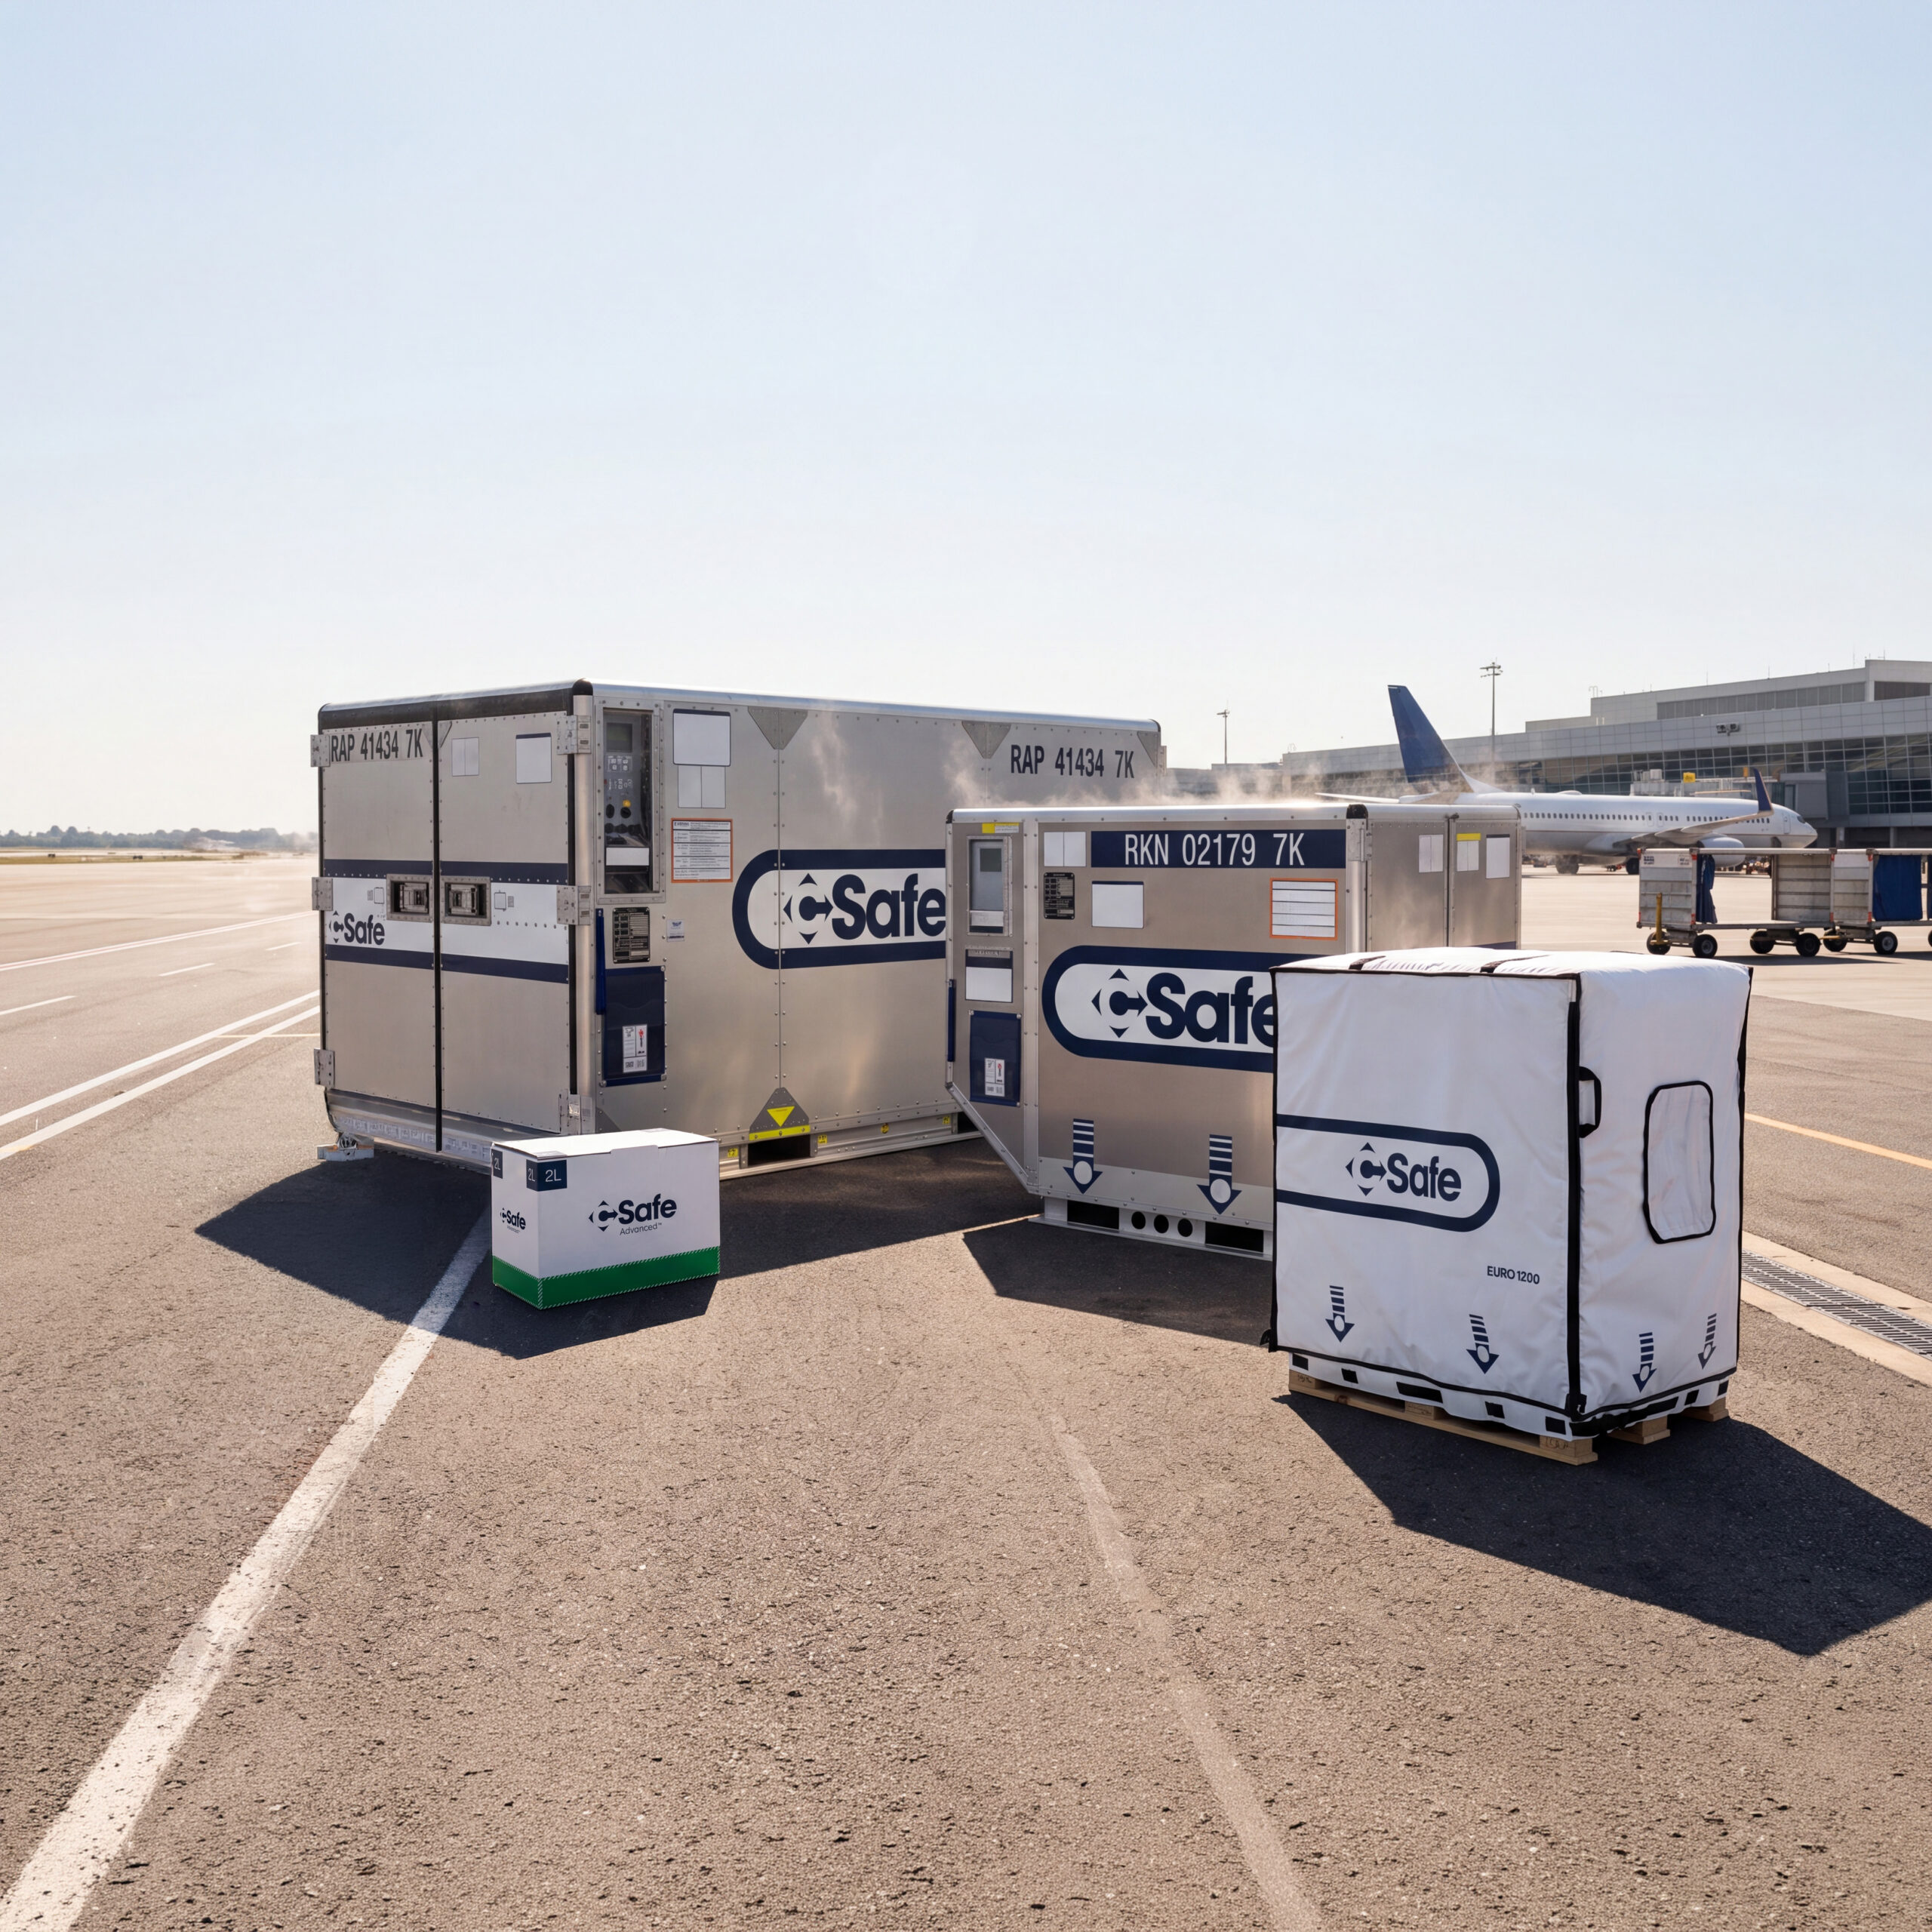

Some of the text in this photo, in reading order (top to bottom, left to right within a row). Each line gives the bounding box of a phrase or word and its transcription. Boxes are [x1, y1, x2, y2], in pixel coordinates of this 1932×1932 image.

[331, 728, 423, 762] RAP 41434 7K
[1011, 744, 1134, 779] RAP 41434 7K
[1124, 832, 1305, 866] RKN 02179 7K
[494, 1158, 501, 1171] 2L
[528, 1168, 536, 1182] 2L
[545, 1168, 562, 1183] 2L
[1487, 1265, 1540, 1285] EURO 1200
